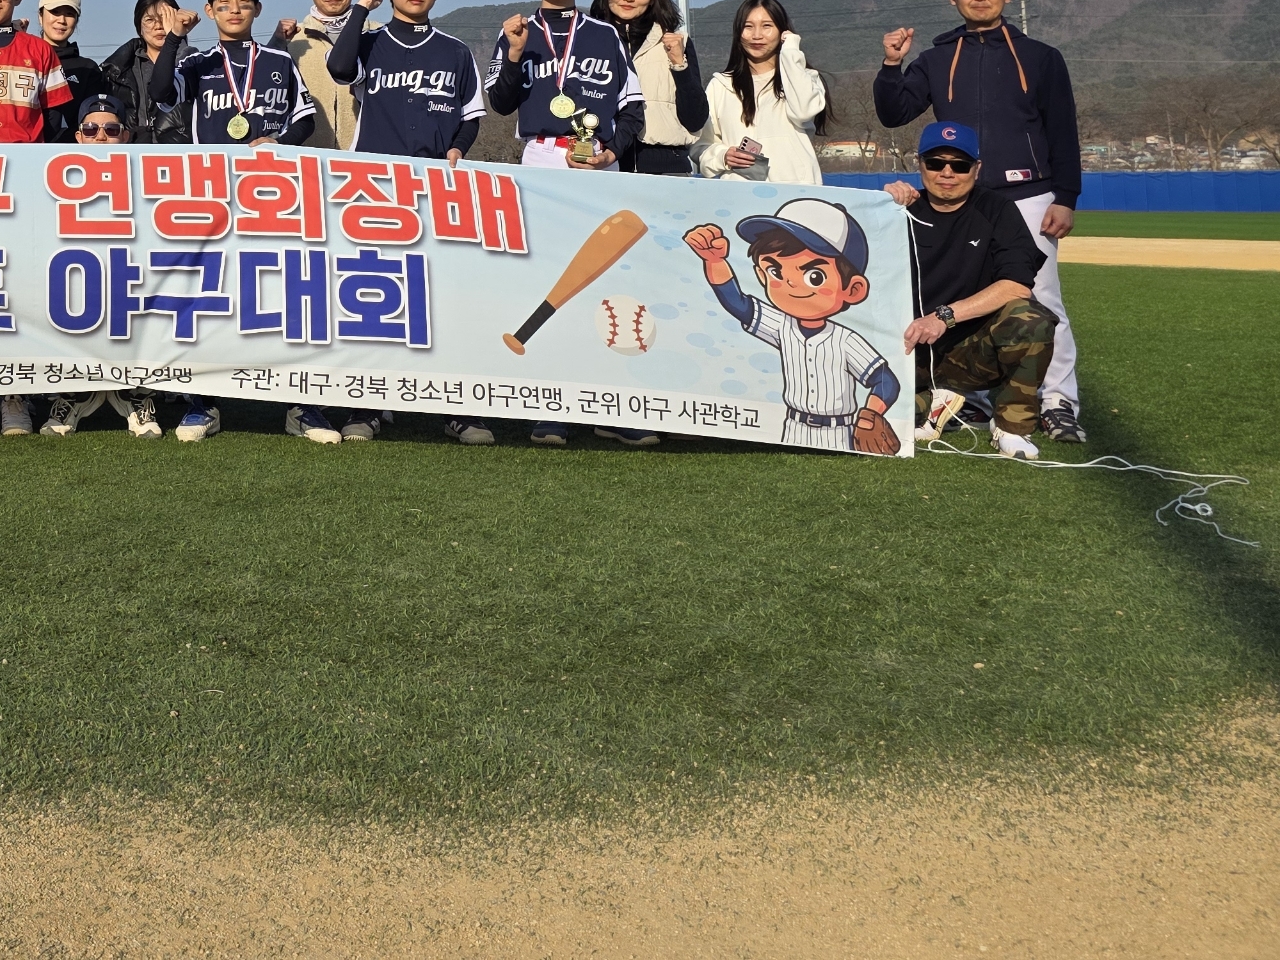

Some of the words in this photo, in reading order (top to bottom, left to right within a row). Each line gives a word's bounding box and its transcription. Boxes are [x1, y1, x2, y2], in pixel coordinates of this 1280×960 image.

[368, 68, 457, 99] Jung-gu
[427, 100, 455, 114] Junior
[941, 127, 957, 140] C
[45, 148, 528, 254] 연맹회장배
[47, 245, 431, 348] 야구대회
[43, 362, 104, 384] 청소년
[110, 364, 193, 386] 야구연맹
[231, 367, 281, 391] 주관:
[288, 370, 389, 400] 대구·경북
[397, 376, 464, 405] 청소년
[472, 382, 571, 415] 야구연맹,
[577, 390, 621, 417] 군위
[628, 394, 672, 421] 야구
[677, 400, 761, 430] 사관학교
